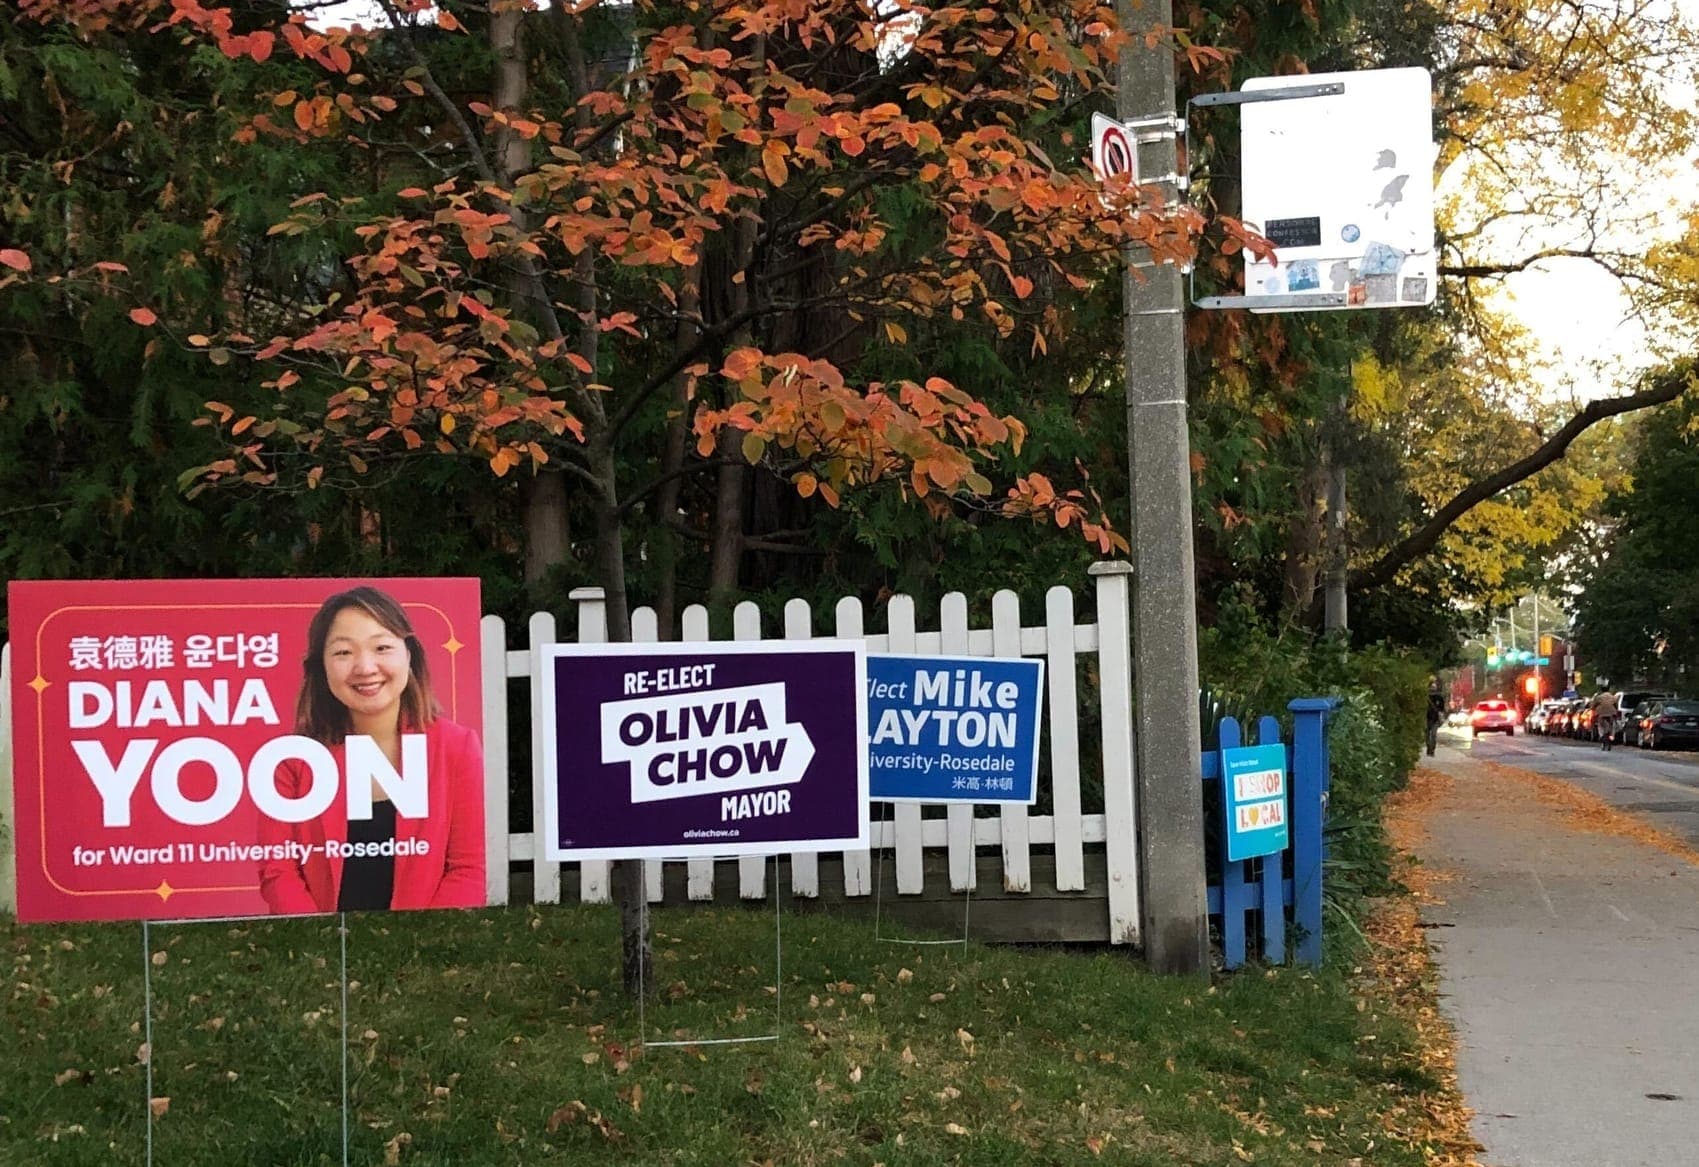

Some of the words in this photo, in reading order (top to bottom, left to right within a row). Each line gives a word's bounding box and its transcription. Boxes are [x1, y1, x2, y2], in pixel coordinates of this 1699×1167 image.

[68, 635, 174, 669] 袁德雅
[183, 633, 279, 668] 윤다영
[624, 664, 716, 695] RE-ELECT
[867, 678, 908, 699] lect
[913, 669, 1019, 709] Mike
[68, 679, 280, 729] DIANA
[619, 698, 769, 747] OLIVIA
[868, 709, 1017, 748] AYTON
[648, 738, 788, 786] CHOW
[870, 751, 1015, 774] iversity-Rosedale
[70, 734, 429, 828] YOON
[721, 789, 791, 822] MAYOR
[73, 845, 105, 866] for
[110, 843, 173, 865] Ward
[178, 843, 194, 862] 11
[200, 836, 430, 865] University-Rosedale
[683, 829, 740, 838] oliviachow.ca
